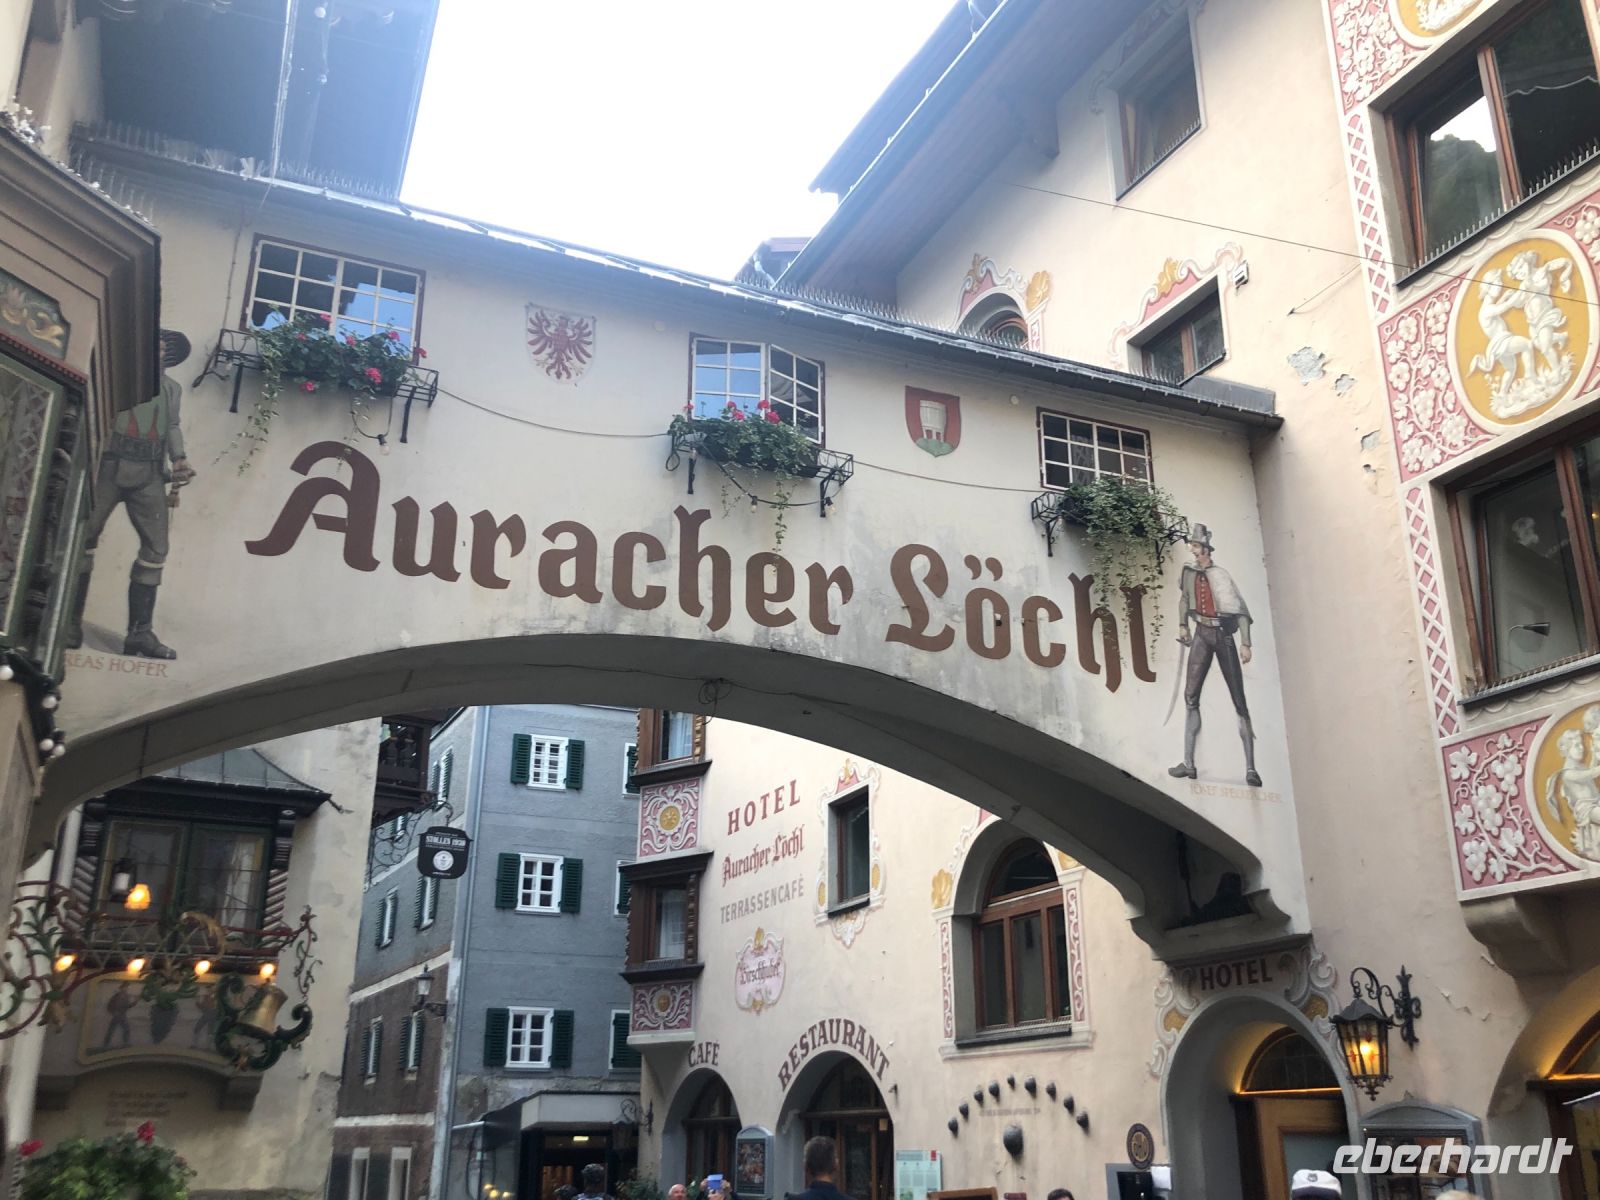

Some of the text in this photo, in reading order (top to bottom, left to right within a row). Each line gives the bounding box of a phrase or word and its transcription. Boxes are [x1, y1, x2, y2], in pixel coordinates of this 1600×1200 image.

[244, 440, 1157, 693] Auracher Löchl
[108, 658, 168, 678] HOFER
[727, 779, 801, 836] HOTEL
[721, 823, 805, 888] Auracher Löchl
[720, 873, 804, 924] TERRASSENCAFÉ
[1200, 958, 1273, 991] HOTEL
[688, 1040, 720, 1068] CAFÉ
[778, 1018, 890, 1092] RESTAURANT
